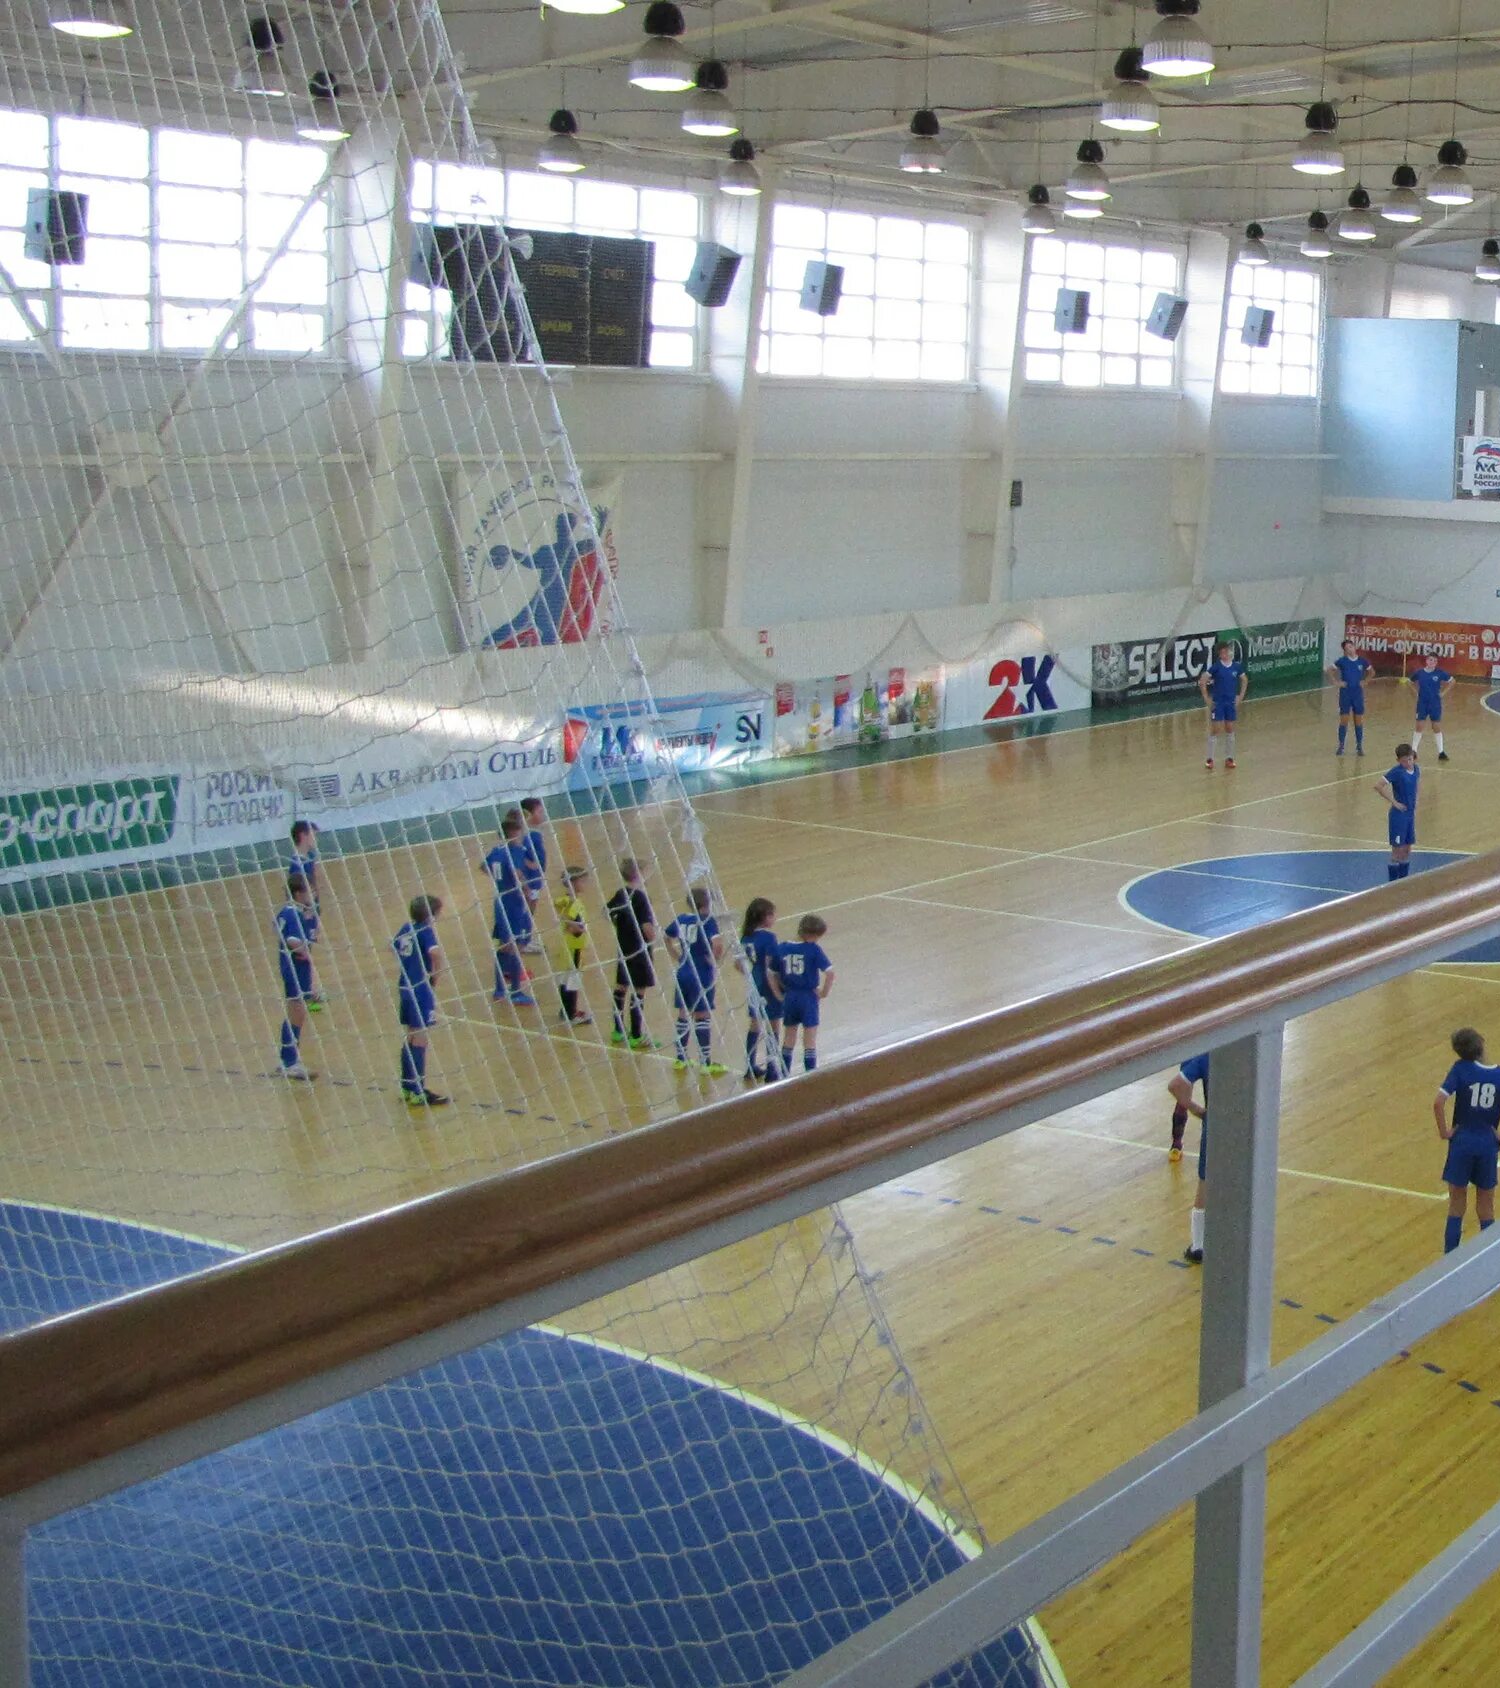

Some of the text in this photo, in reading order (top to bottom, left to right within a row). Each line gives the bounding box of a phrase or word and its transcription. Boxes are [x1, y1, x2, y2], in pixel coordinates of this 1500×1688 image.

[1249, 631, 1319, 657] МЕГАФОН
[1439, 632, 1478, 643] ПРОЕКТ
[1128, 637, 1216, 685] SELECT
[1469, 646, 1479, 660] В
[736, 714, 762, 743] SV
[783, 954, 805, 975] 15
[1468, 1082, 1496, 1108] 18
